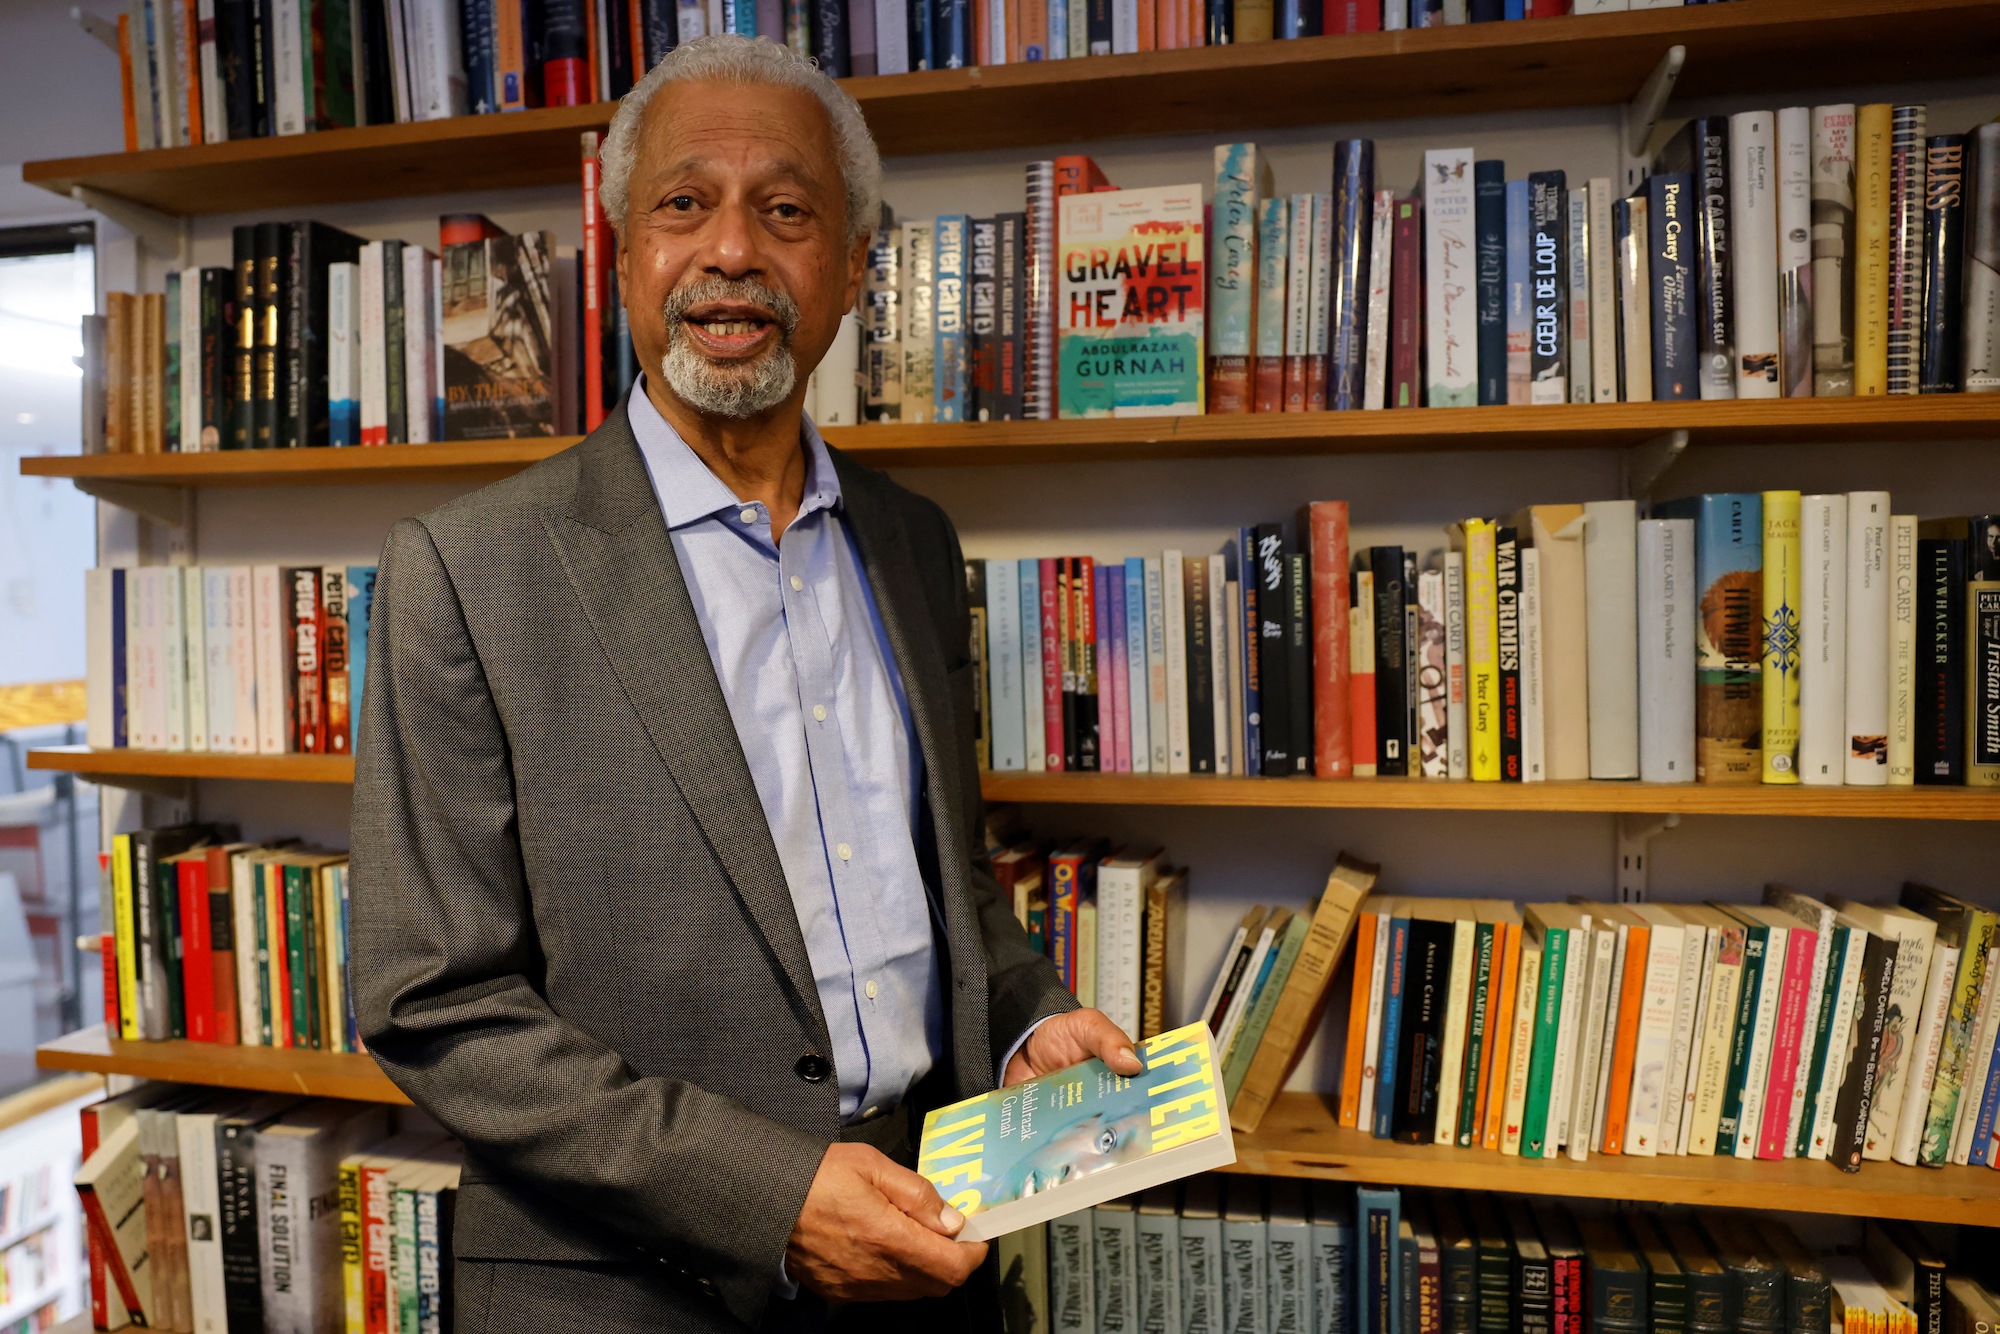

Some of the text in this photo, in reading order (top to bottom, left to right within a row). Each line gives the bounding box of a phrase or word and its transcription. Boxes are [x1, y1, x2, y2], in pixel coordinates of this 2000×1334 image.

[1823, 115, 1855, 123] PETER
[1755, 145, 1767, 191] Peter Carey
[1870, 133, 1882, 167] PETER
[1434, 196, 1468, 205] PETER
[1747, 146, 1757, 208] Collected Stories
[1869, 171, 1882, 209] CAREY
[1926, 145, 1963, 210] BLISS
[1432, 207, 1467, 216] CAREY
[1535, 183, 1546, 227] KATHERINE
[1547, 185, 1558, 222] RUNDELL
[1572, 201, 1585, 244] PETER
[1662, 183, 1682, 262] Peter Carey
[1219, 174, 1254, 291] Peter Carey
[1536, 231, 1557, 274] LOUP
[1704, 135, 1727, 346] PETER CAREY HIS ILLEGAL SELF
[1868, 238, 1881, 258] MY
[1066, 242, 1198, 282] GRAVEL
[1573, 246, 1586, 290] CAREY
[1868, 262, 1881, 288] LIFE
[1069, 285, 1193, 328] HEART
[1537, 277, 1556, 299] DE
[1663, 275, 1676, 315] Olivier
[1676, 265, 1689, 316] Parrot and
[1986, 289, 1995, 325] PETER
[1081, 342, 1179, 356] ABDULRAZAK
[1664, 322, 1677, 368] America
[1867, 320, 1880, 348] FAKE
[1077, 357, 1184, 377] GURNAH
[1732, 501, 1742, 543] CAREY
[1767, 520, 1799, 530] JACK
[1862, 526, 1873, 589] Collected Stories
[1871, 526, 1884, 573] Peter Carey
[1149, 570, 1164, 656] PETER CAREY
[1193, 562, 1205, 647] PETER CAREY
[1663, 529, 1677, 659] PETER CAREY Illywhacker
[1042, 590, 1056, 700] CAREY
[1448, 565, 1464, 703] PETER CAREY WAR CRIMES
[1471, 530, 1494, 733] War Crimes Peter Carey
[1724, 588, 1752, 700] ILLYWHACKER
[1896, 525, 1913, 744] PETER CAREY THE TAX INSPECTOR
[1935, 548, 1949, 751] ILLYWHACKER PETER CAREY
[1497, 541, 1519, 778] WAR CRIMES PETER CAREY UQP
[138, 844, 149, 860] THE
[1053, 863, 1074, 896] OLD
[1105, 882, 1117, 1001] BURNING YOUR
[1144, 902, 1165, 1029] SADEIAN WOMAN
[1478, 932, 1493, 982] ANGELA
[1422, 942, 1438, 1022] ANGELA CARTER
[1545, 933, 1562, 1025] THE MAGIC TOYSHOP
[1473, 986, 1487, 1037] CARTER
[1512, 957, 1538, 1102] Angela Carter ARTIFICIAL FIRE
[1745, 933, 1781, 1127] ANGELA CARTER NOTHING SACRED
[1819, 936, 1860, 1128] ANGELA CARTER NOTHING SACRED
[1921, 961, 1955, 1092] A CARD FROM ANGELA CARTER
[1706, 1044, 1717, 1075] ANGELA
[1853, 956, 1895, 1146] ANGELA CARTER THE BLOODY CHAMBER
[1144, 1020, 1220, 1156] AFTER
[1700, 1077, 1712, 1113] CARTER
[1708, 1060, 1722, 1099] Edited by
[1977, 1068, 2000, 1141] ANGELA CARTER
[1001, 1094, 1018, 1140] Gurnah
[1021, 1082, 1040, 1142] Abdulrazak
[269, 1164, 293, 1293] FINAL SOLUTION
[1058, 1223, 1083, 1329] RAYMOND CHANDLER
[1100, 1226, 1124, 1333] RAYMOND CHANDLER
[1568, 1260, 1581, 1313] RAYMOND
